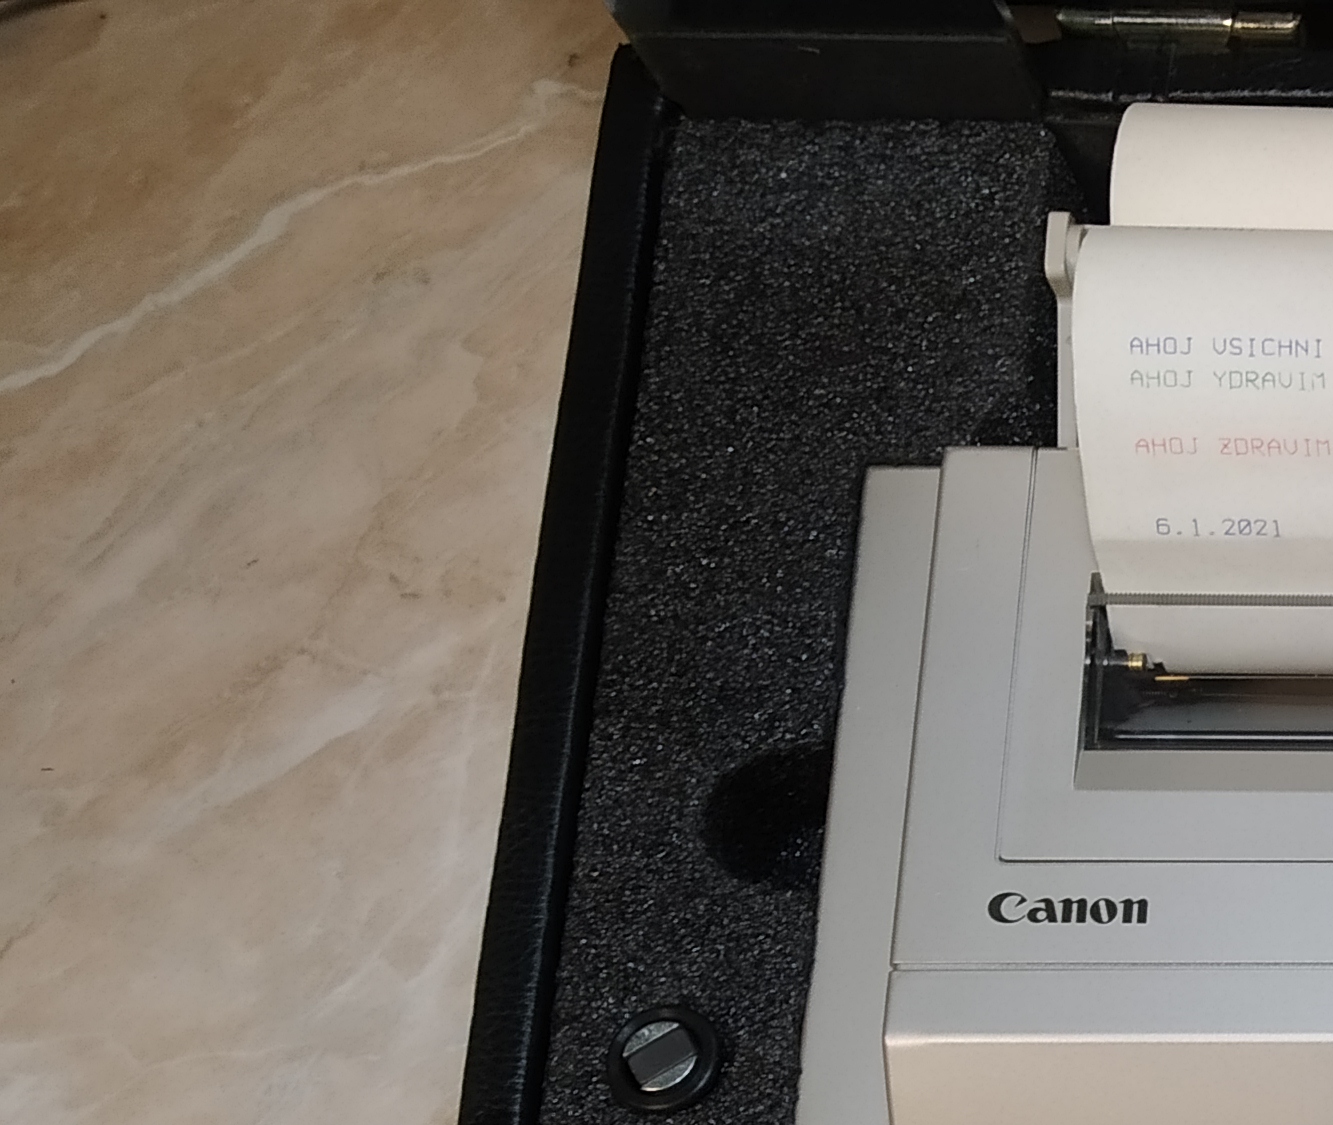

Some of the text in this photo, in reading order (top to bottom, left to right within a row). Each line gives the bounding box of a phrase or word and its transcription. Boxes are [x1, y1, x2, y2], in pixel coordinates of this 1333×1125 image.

[1129, 336, 1322, 358] AHOJ VSICHNI
[1129, 369, 1193, 389] AHOJ
[1213, 370, 1326, 391] YDRAVIM
[1135, 437, 1198, 456] AHOJ
[1219, 437, 1331, 457] ZDRAVIM
[1155, 518, 1282, 538] 6.1.2021
[987, 891, 1149, 925] Canon
